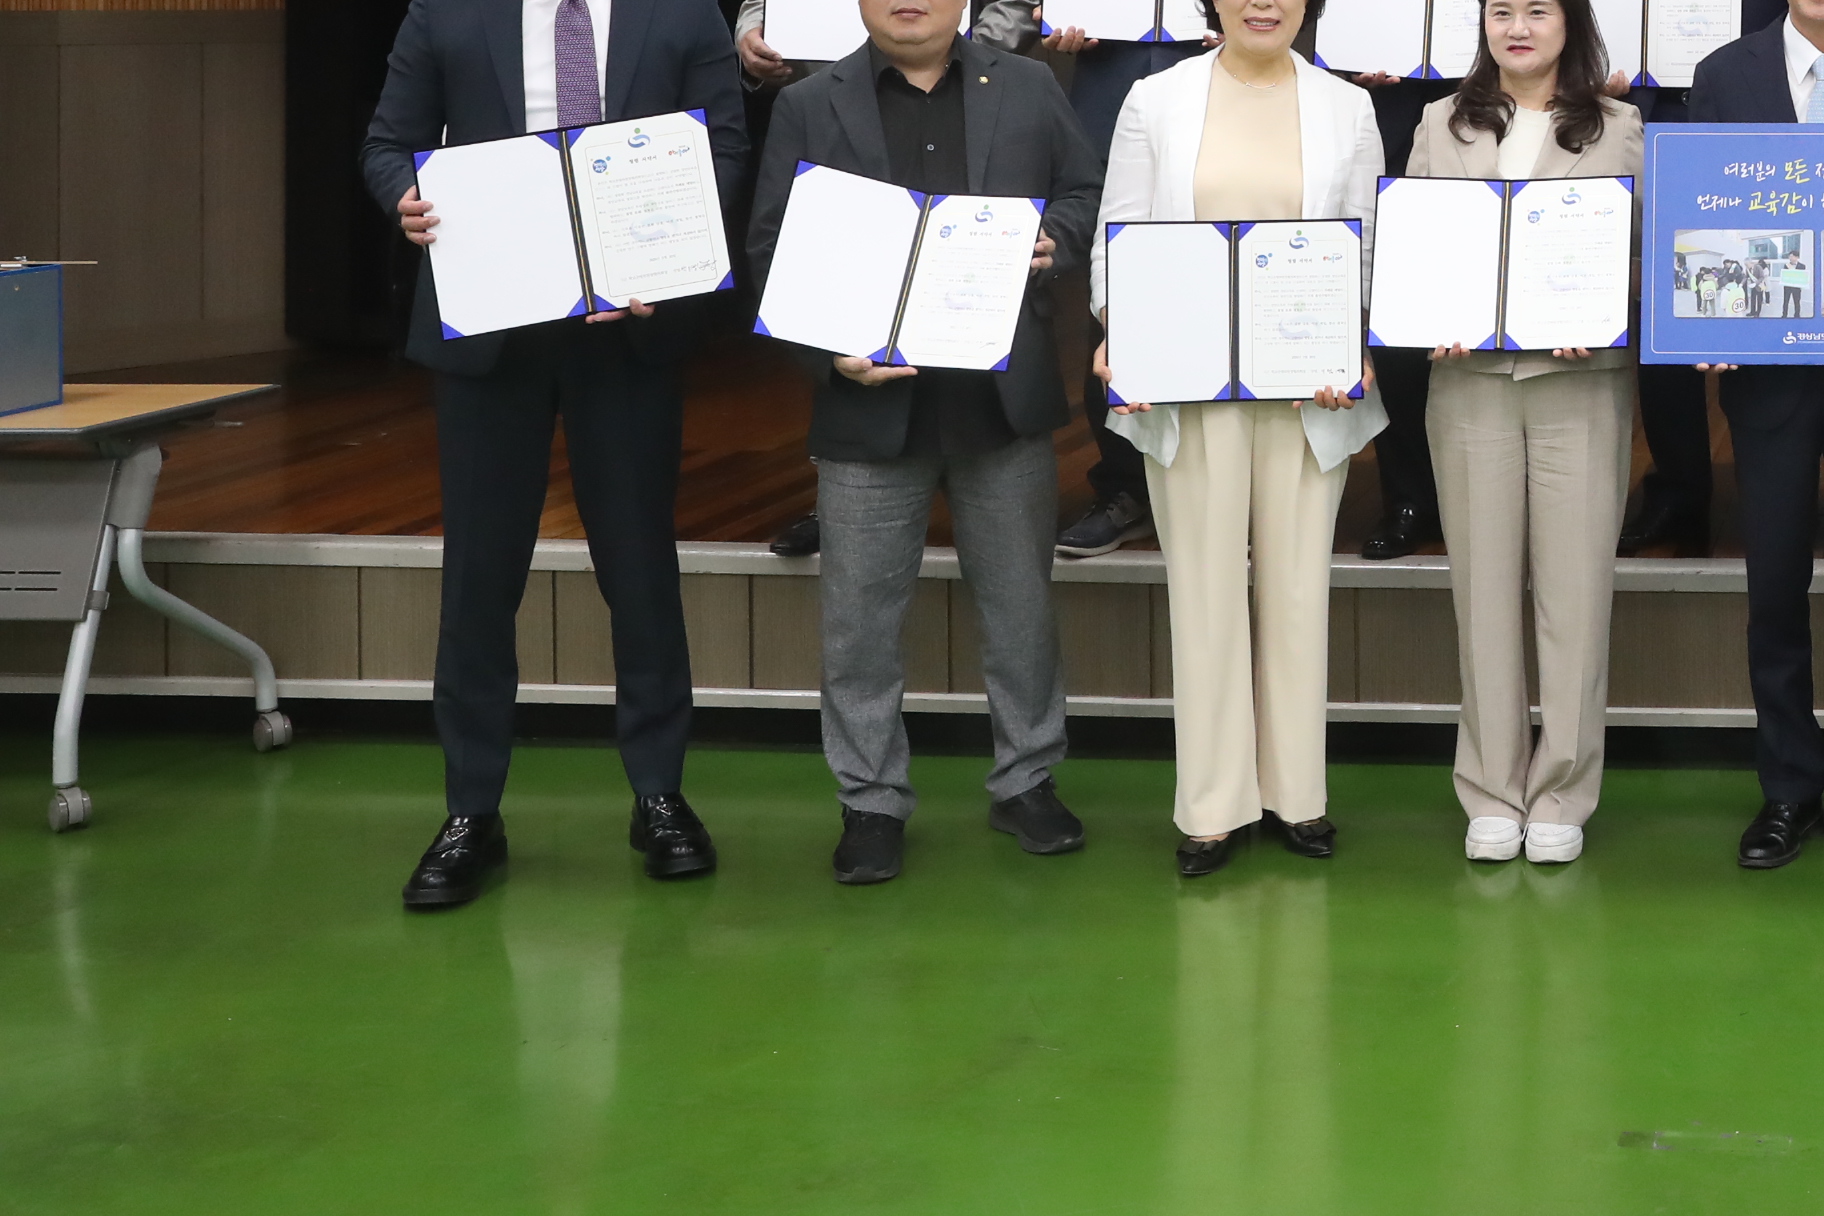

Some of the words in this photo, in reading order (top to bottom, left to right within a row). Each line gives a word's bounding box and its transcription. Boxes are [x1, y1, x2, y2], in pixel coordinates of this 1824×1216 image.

[1724, 161, 1775, 182] 여러분의
[1784, 159, 1811, 184] 모든
[1696, 194, 1742, 211] 언제나
[1748, 190, 1814, 216] 교육감이
